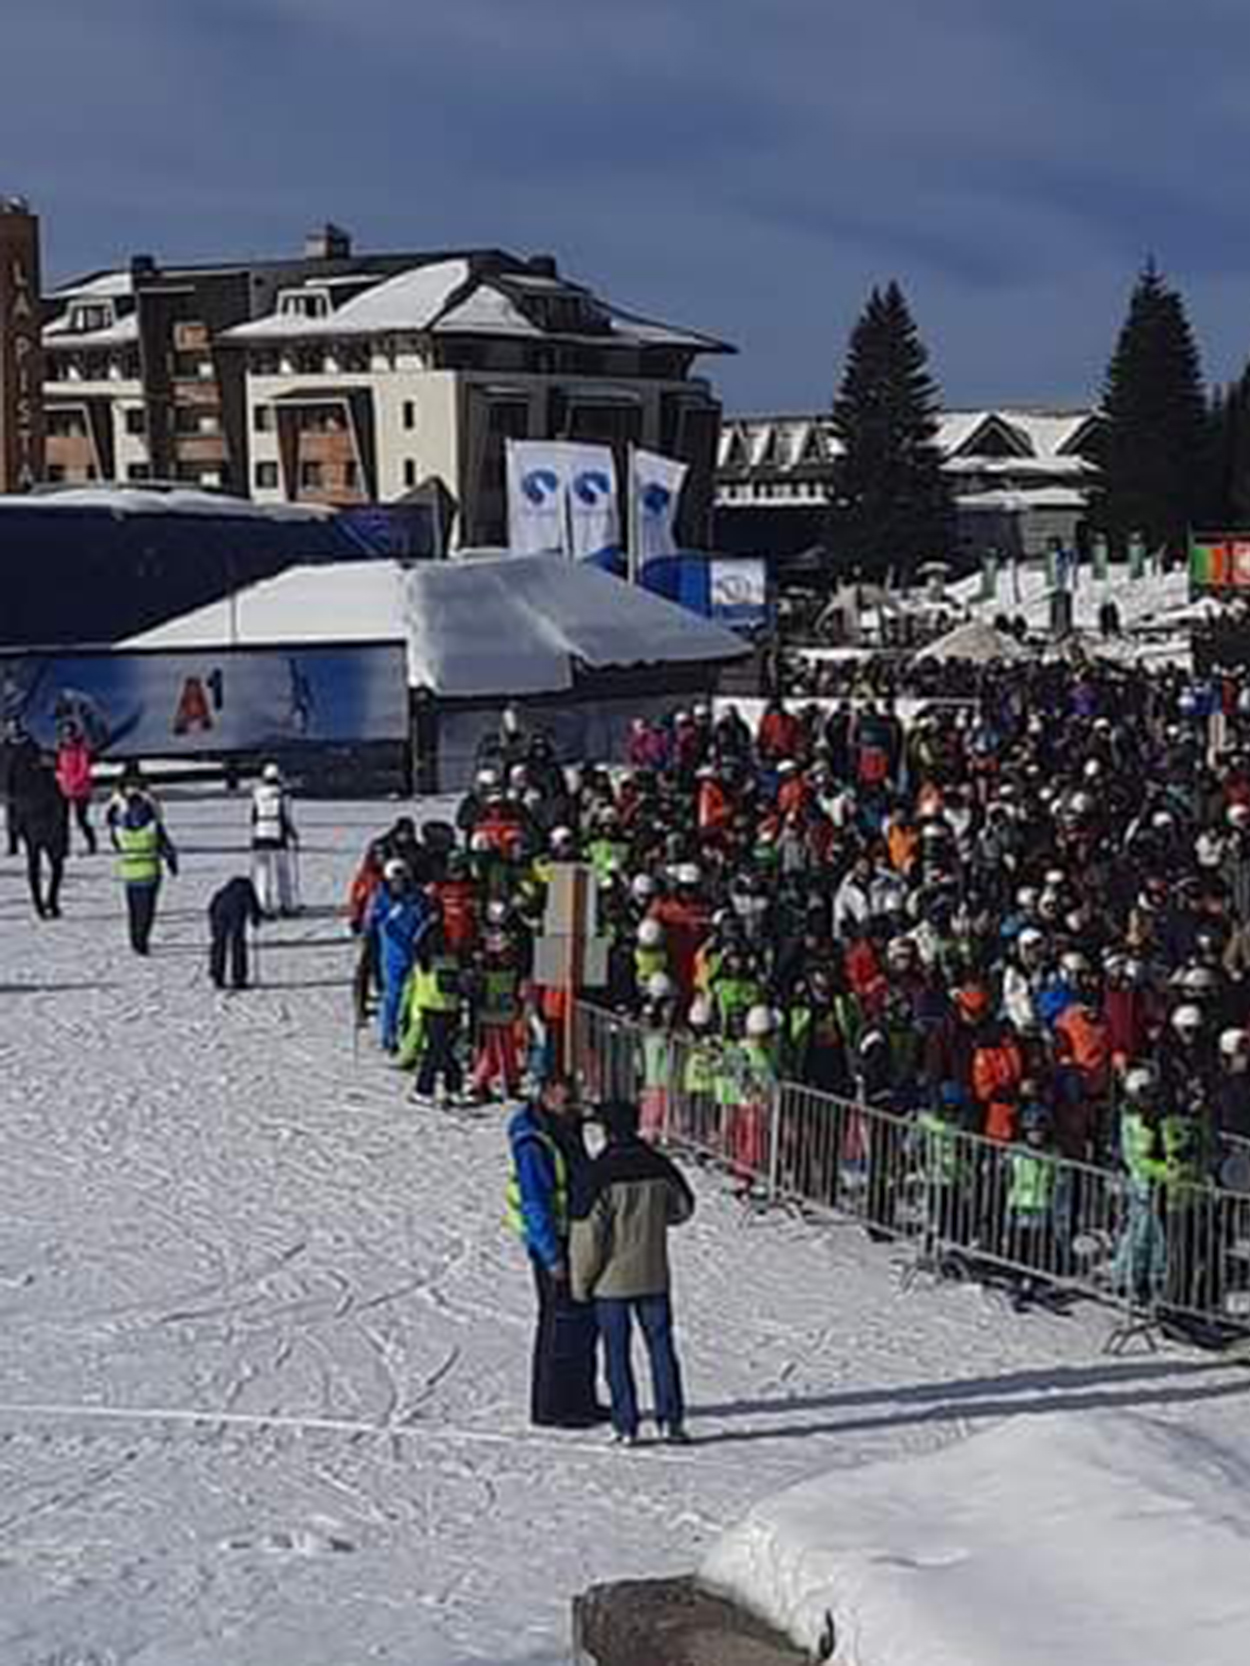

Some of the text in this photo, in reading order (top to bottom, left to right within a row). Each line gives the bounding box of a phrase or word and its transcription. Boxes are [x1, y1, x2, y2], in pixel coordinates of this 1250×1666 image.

[12, 260, 34, 485] LA PISTA
[173, 668, 224, 737] A1
